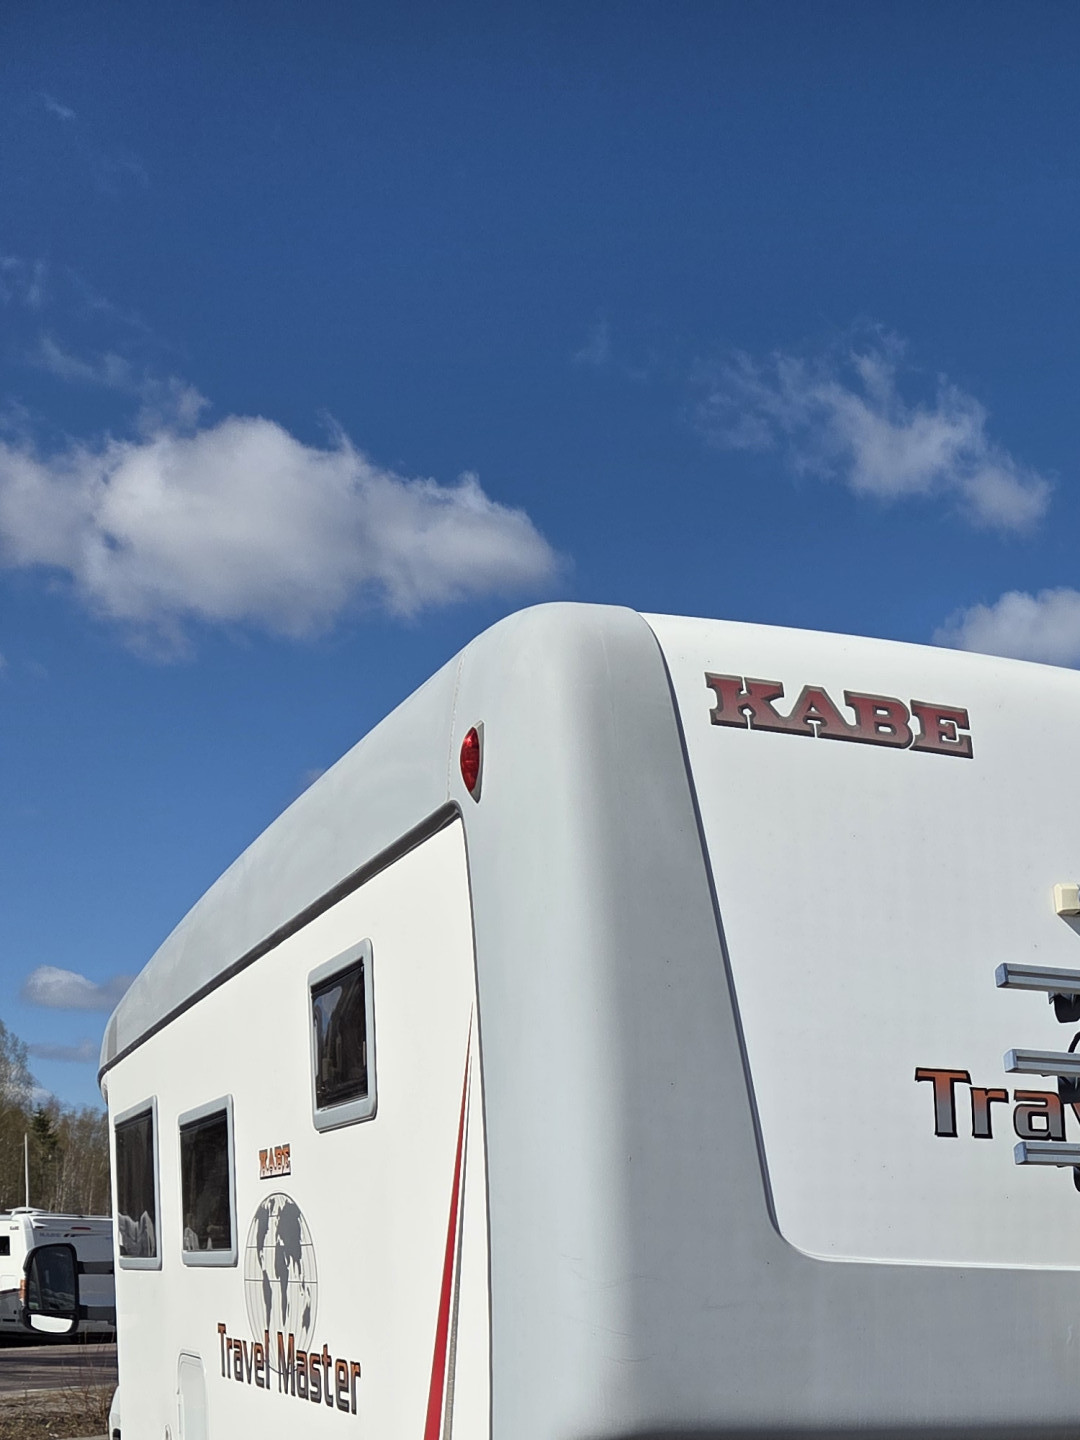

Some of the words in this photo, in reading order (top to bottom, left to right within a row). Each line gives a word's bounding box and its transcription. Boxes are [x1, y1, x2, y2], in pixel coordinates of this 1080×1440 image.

[704, 672, 974, 759] KABE
[259, 1144, 291, 1180] KABE
[217, 1323, 271, 1390] Travel
[277, 1331, 361, 1415] Master
